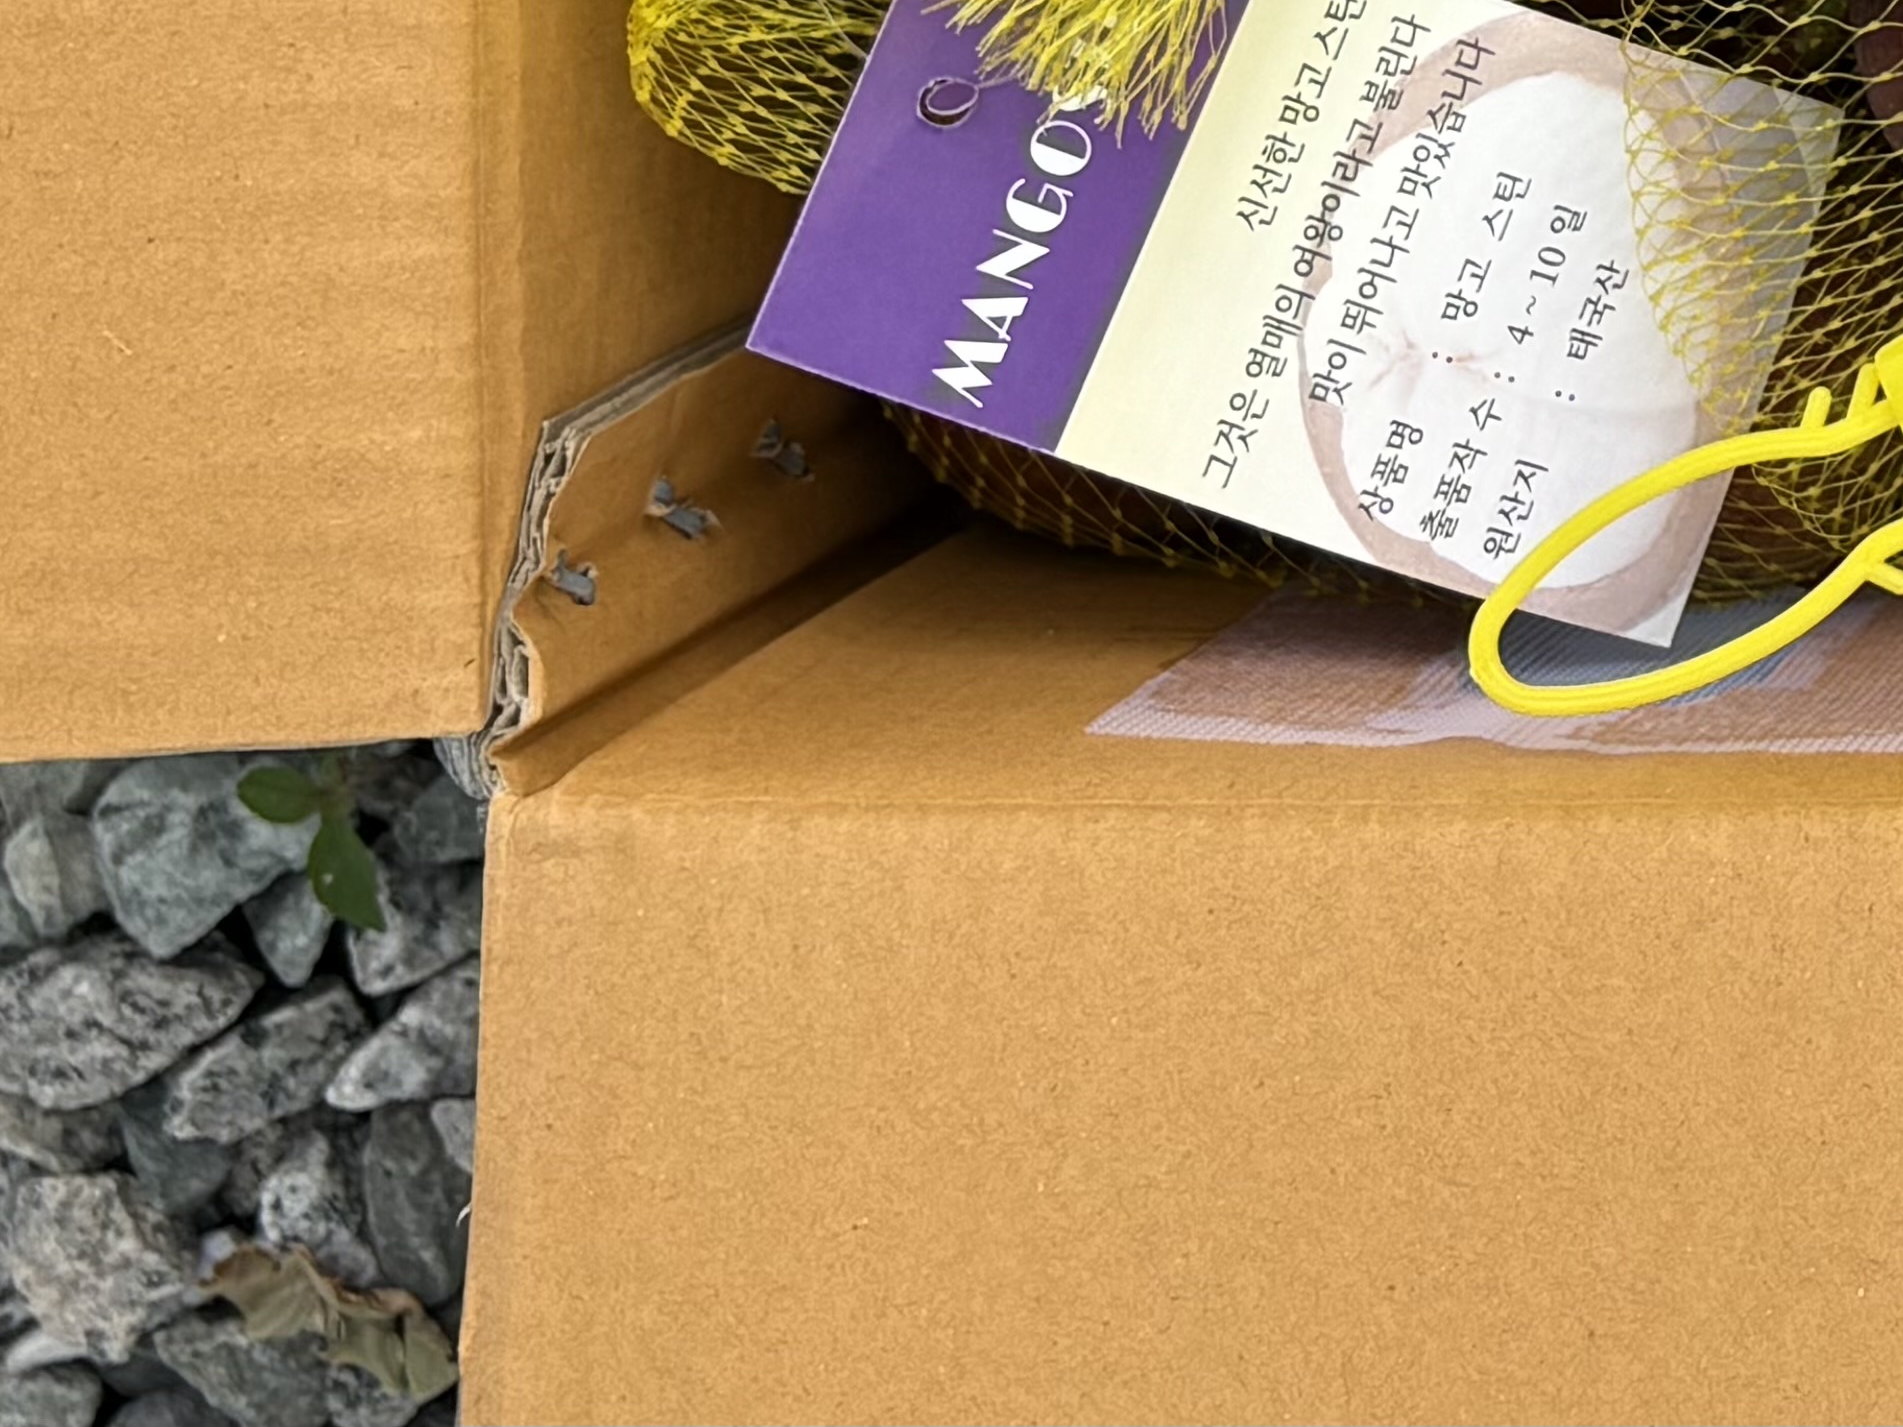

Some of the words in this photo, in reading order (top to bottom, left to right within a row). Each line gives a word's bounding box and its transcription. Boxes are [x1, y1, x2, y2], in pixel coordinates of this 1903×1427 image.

[1201, 387, 1270, 489] 그것은
[1244, 282, 1317, 378] 열매의
[1291, 117, 1384, 278] 여왕이라고
[1358, 13, 1432, 112] 불린다
[1235, 130, 1306, 231] 신선한
[1277, 61, 1333, 125] 망고
[1307, 337, 1367, 405] 맛이
[1339, 204, 1420, 335] 뛰어나고
[1396, 36, 1496, 199] 맛있습니다
[1356, 418, 1424, 522] 상품명
[1440, 257, 1492, 321] 망고
[1481, 170, 1532, 241] 스틴
[1418, 437, 1488, 541] 출품작
[1468, 397, 1503, 431] 수
[1506, 324, 1535, 345] 4
[1528, 245, 1567, 286] 10
[1549, 203, 1588, 234] 일
[1482, 458, 1549, 559] 원산지
[1566, 258, 1630, 360] 태국산
